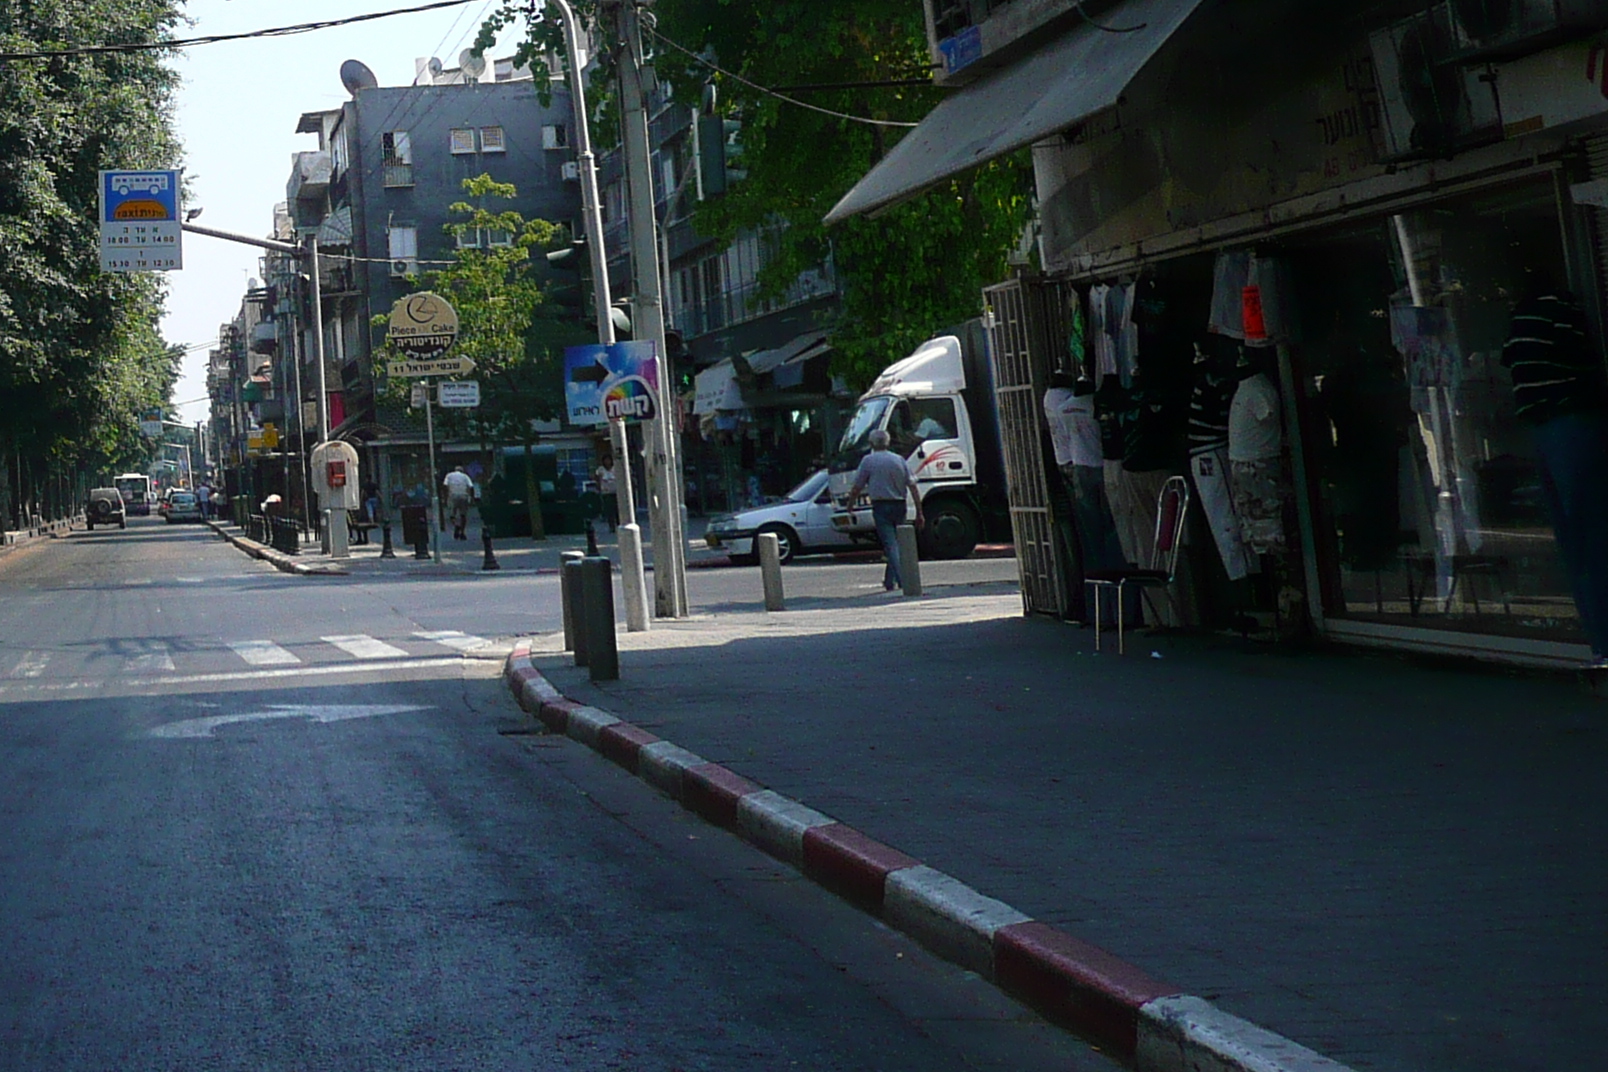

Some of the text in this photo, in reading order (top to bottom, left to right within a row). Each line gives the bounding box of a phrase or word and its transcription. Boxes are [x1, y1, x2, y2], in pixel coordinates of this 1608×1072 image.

[392, 326, 417, 335] Piece
[431, 324, 454, 333] Cake
[396, 335, 451, 348] קונדיטוריה
[406, 362, 435, 372] ישראל
[607, 394, 650, 417] קשת
